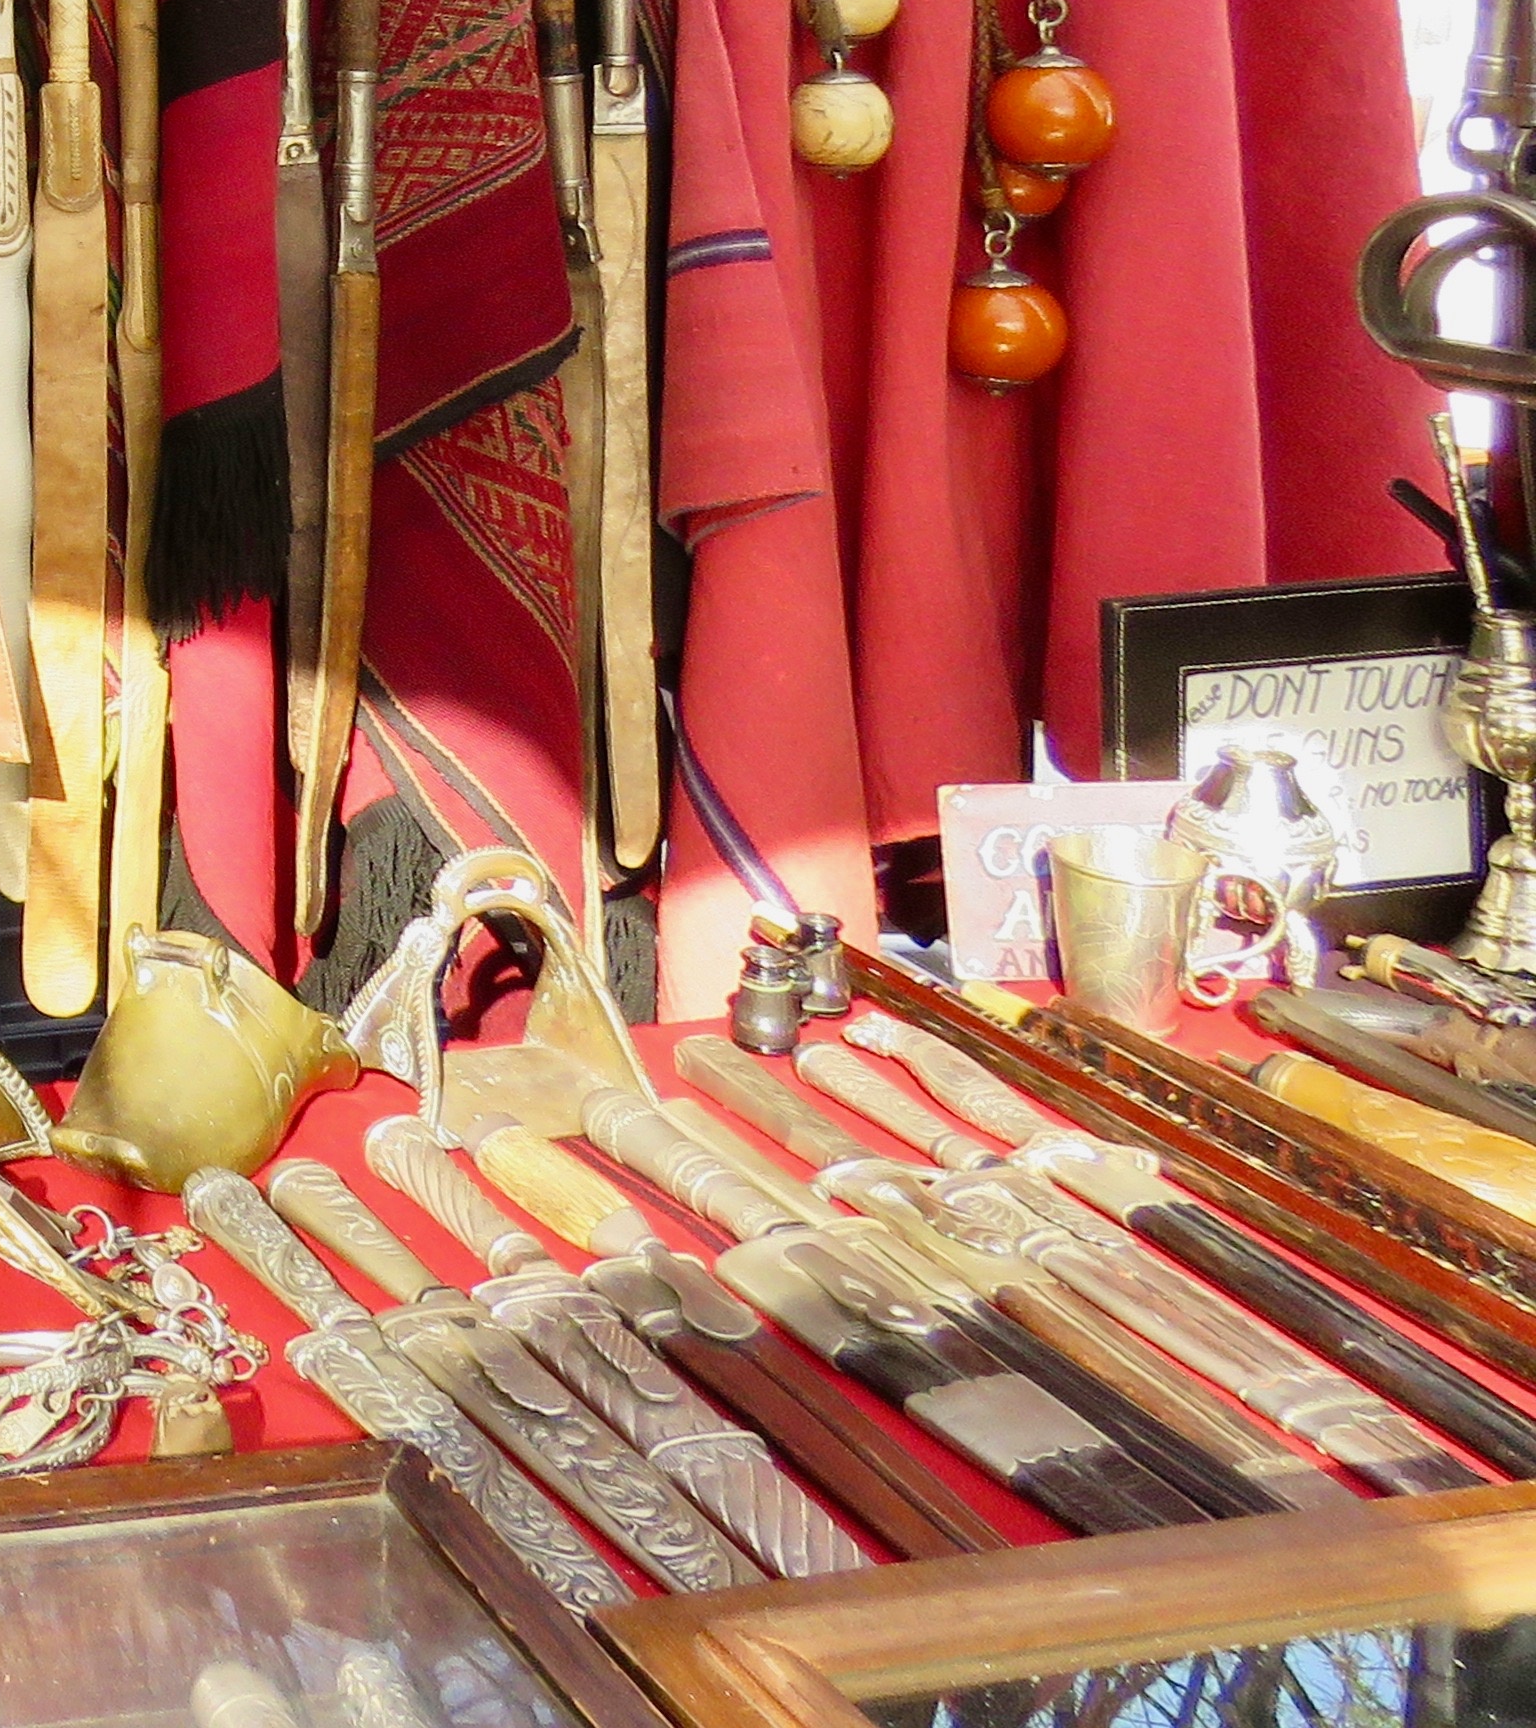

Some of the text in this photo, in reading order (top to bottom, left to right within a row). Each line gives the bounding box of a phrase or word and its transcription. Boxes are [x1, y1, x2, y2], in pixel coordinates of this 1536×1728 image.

[1345, 660, 1451, 712] TOUCH
[1302, 724, 1405, 769] GUNS
[1360, 780, 1398, 809] NO
[1403, 776, 1469, 803] TOCAR
